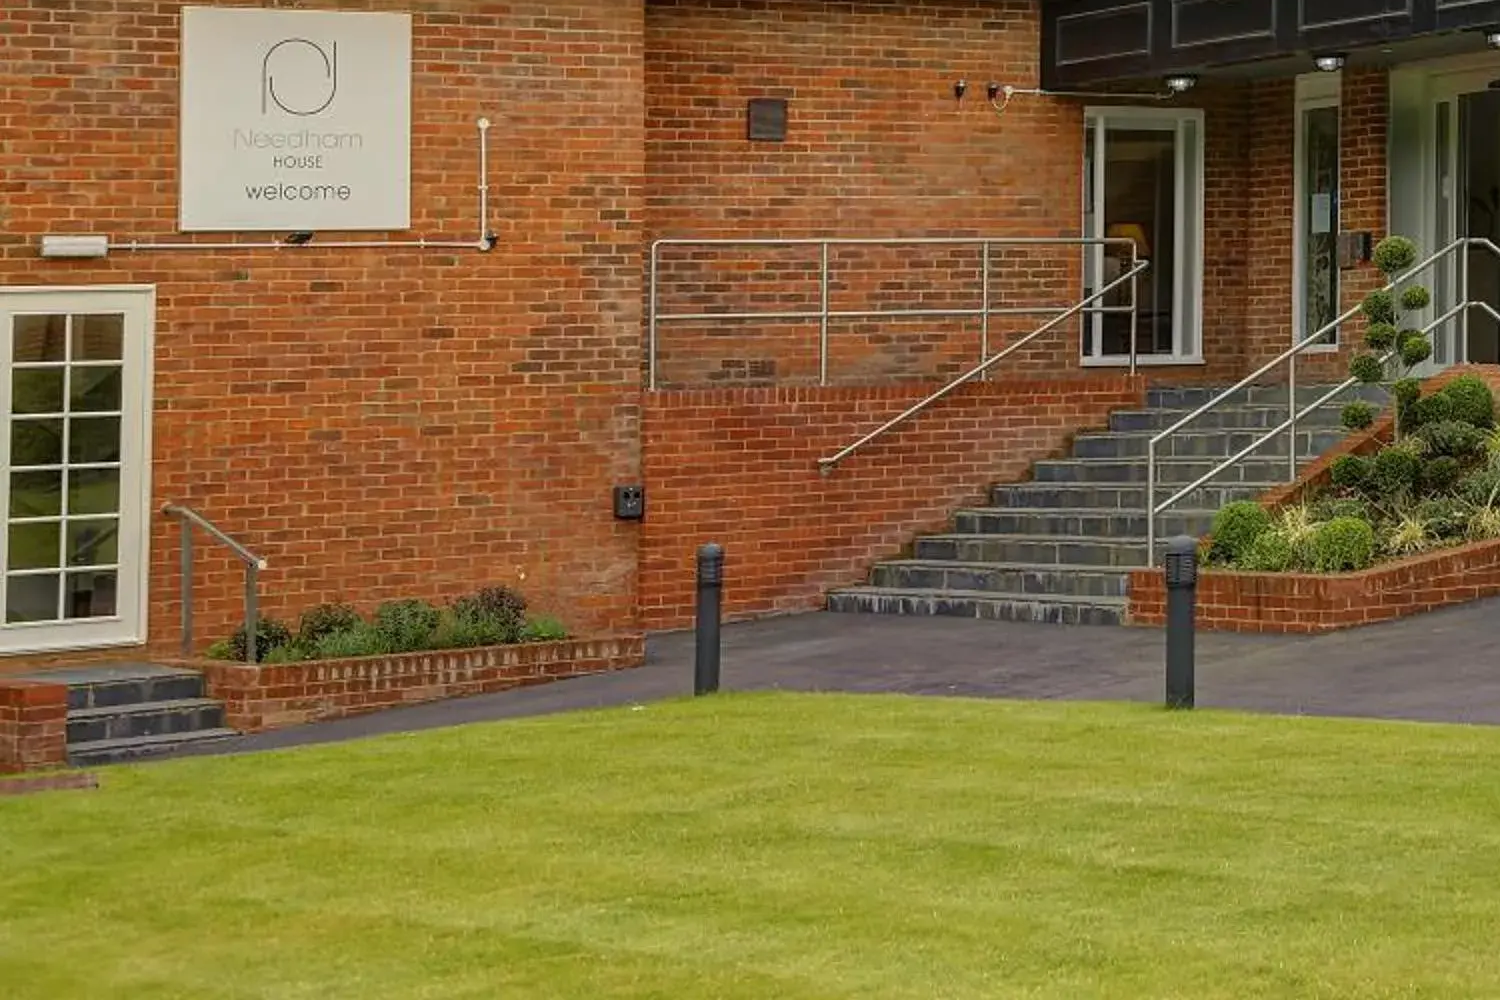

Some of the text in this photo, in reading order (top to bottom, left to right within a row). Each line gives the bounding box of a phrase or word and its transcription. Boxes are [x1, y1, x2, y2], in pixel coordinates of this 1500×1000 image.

[233, 129, 363, 149] Needham
[273, 155, 323, 169] HOUSE
[244, 182, 351, 201] welcome
